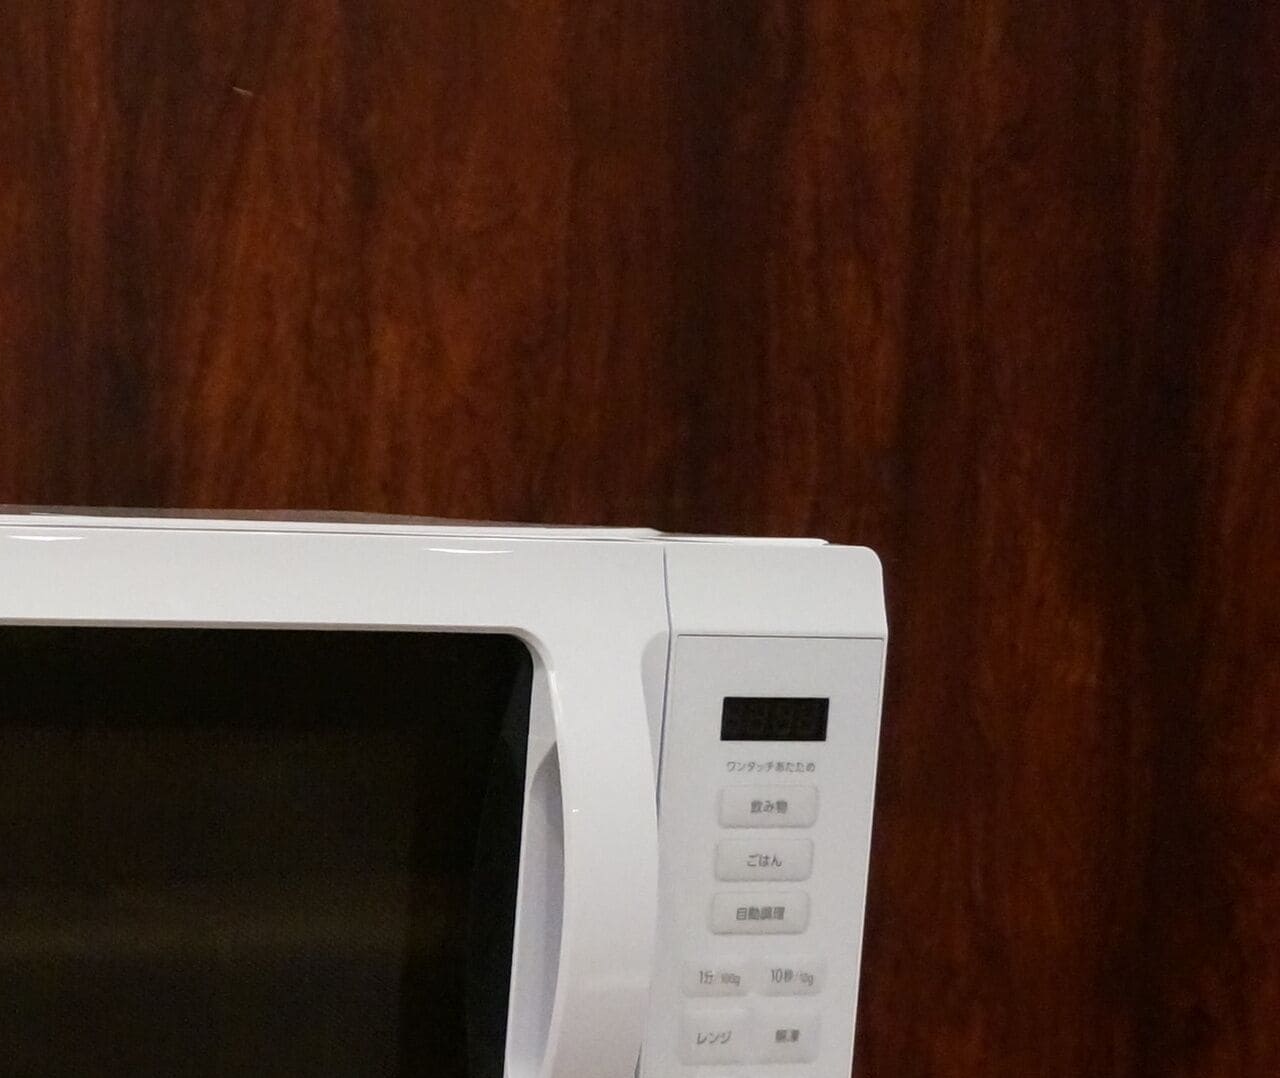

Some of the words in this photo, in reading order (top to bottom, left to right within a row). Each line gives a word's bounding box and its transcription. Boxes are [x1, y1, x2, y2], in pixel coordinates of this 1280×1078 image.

[726, 760, 816, 774] ワンタッチあたため
[750, 799, 789, 815] 飲み物
[746, 853, 783, 868] ごはん
[696, 1030, 732, 1045] レンジ
